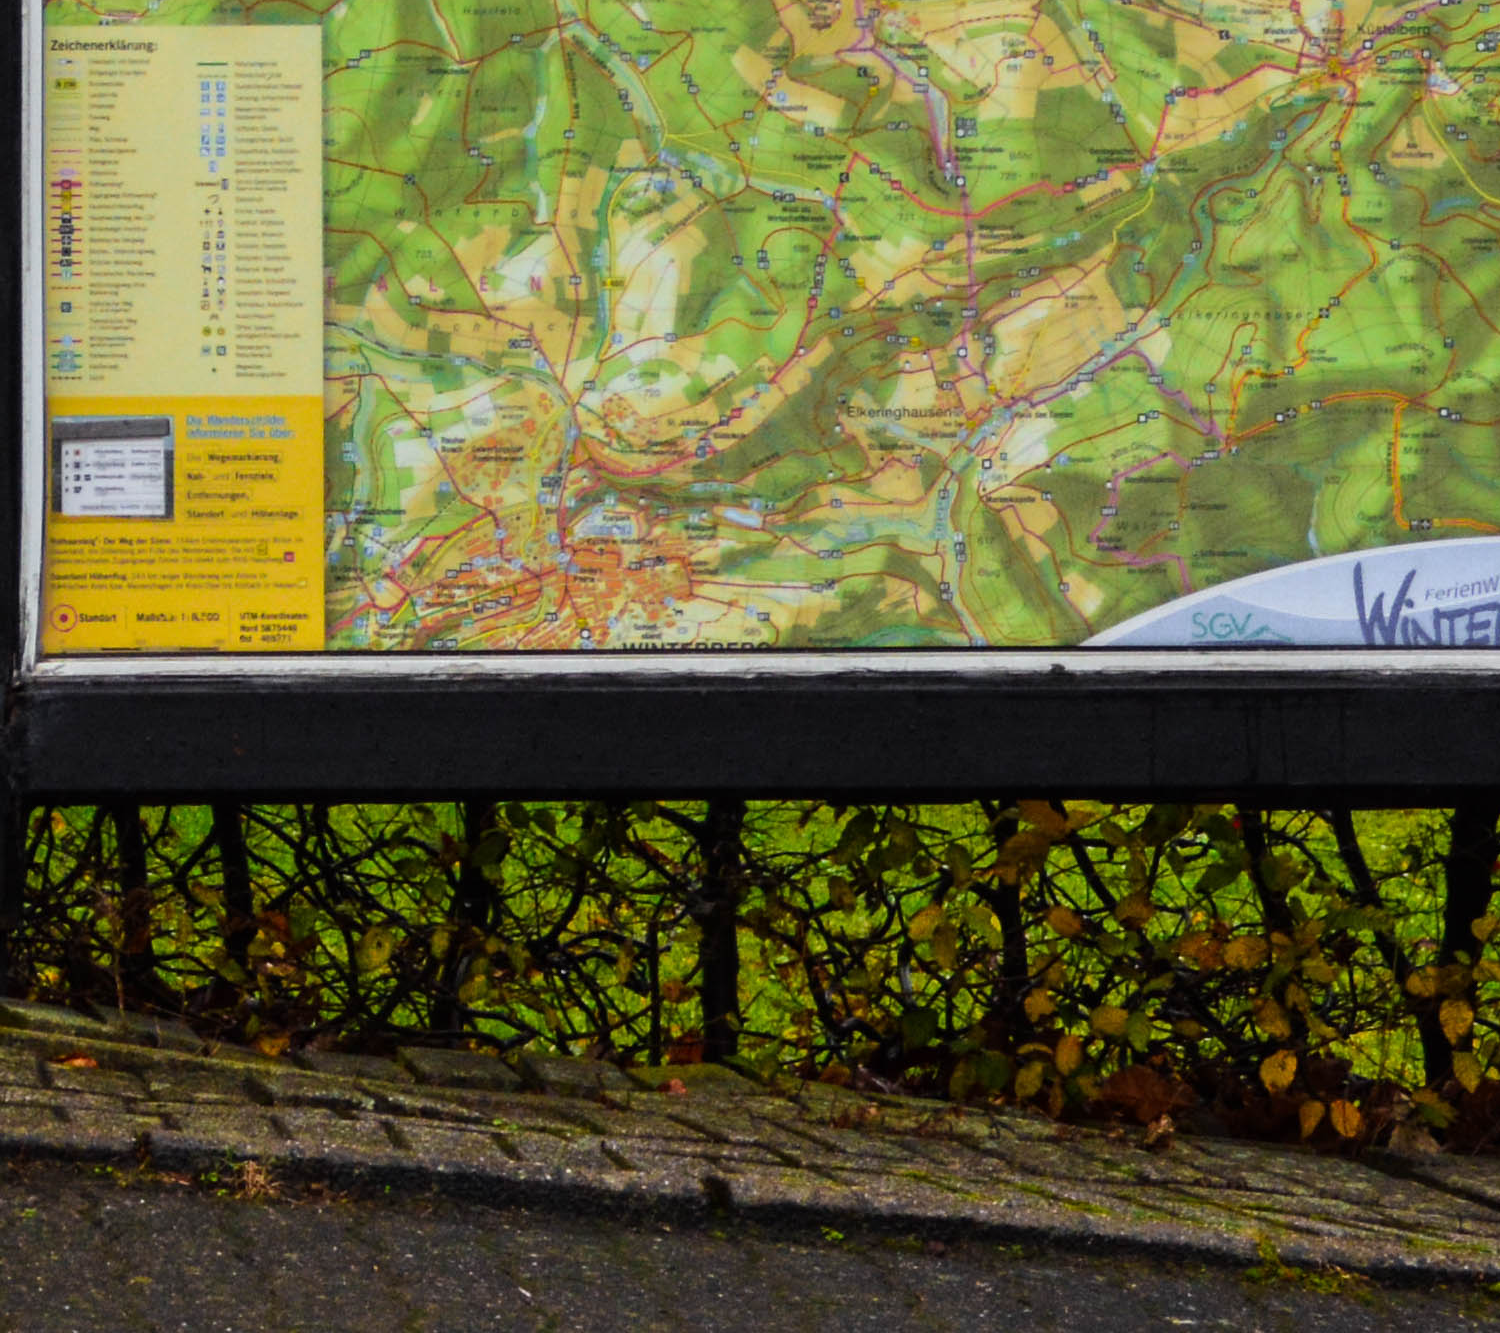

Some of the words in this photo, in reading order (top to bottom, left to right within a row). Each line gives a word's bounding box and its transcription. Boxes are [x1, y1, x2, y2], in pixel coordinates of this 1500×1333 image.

[50, 39, 158, 53] Zeichenerklärung:
[847, 406, 953, 421] Elkeringhausen
[1190, 612, 1251, 639] SGV
